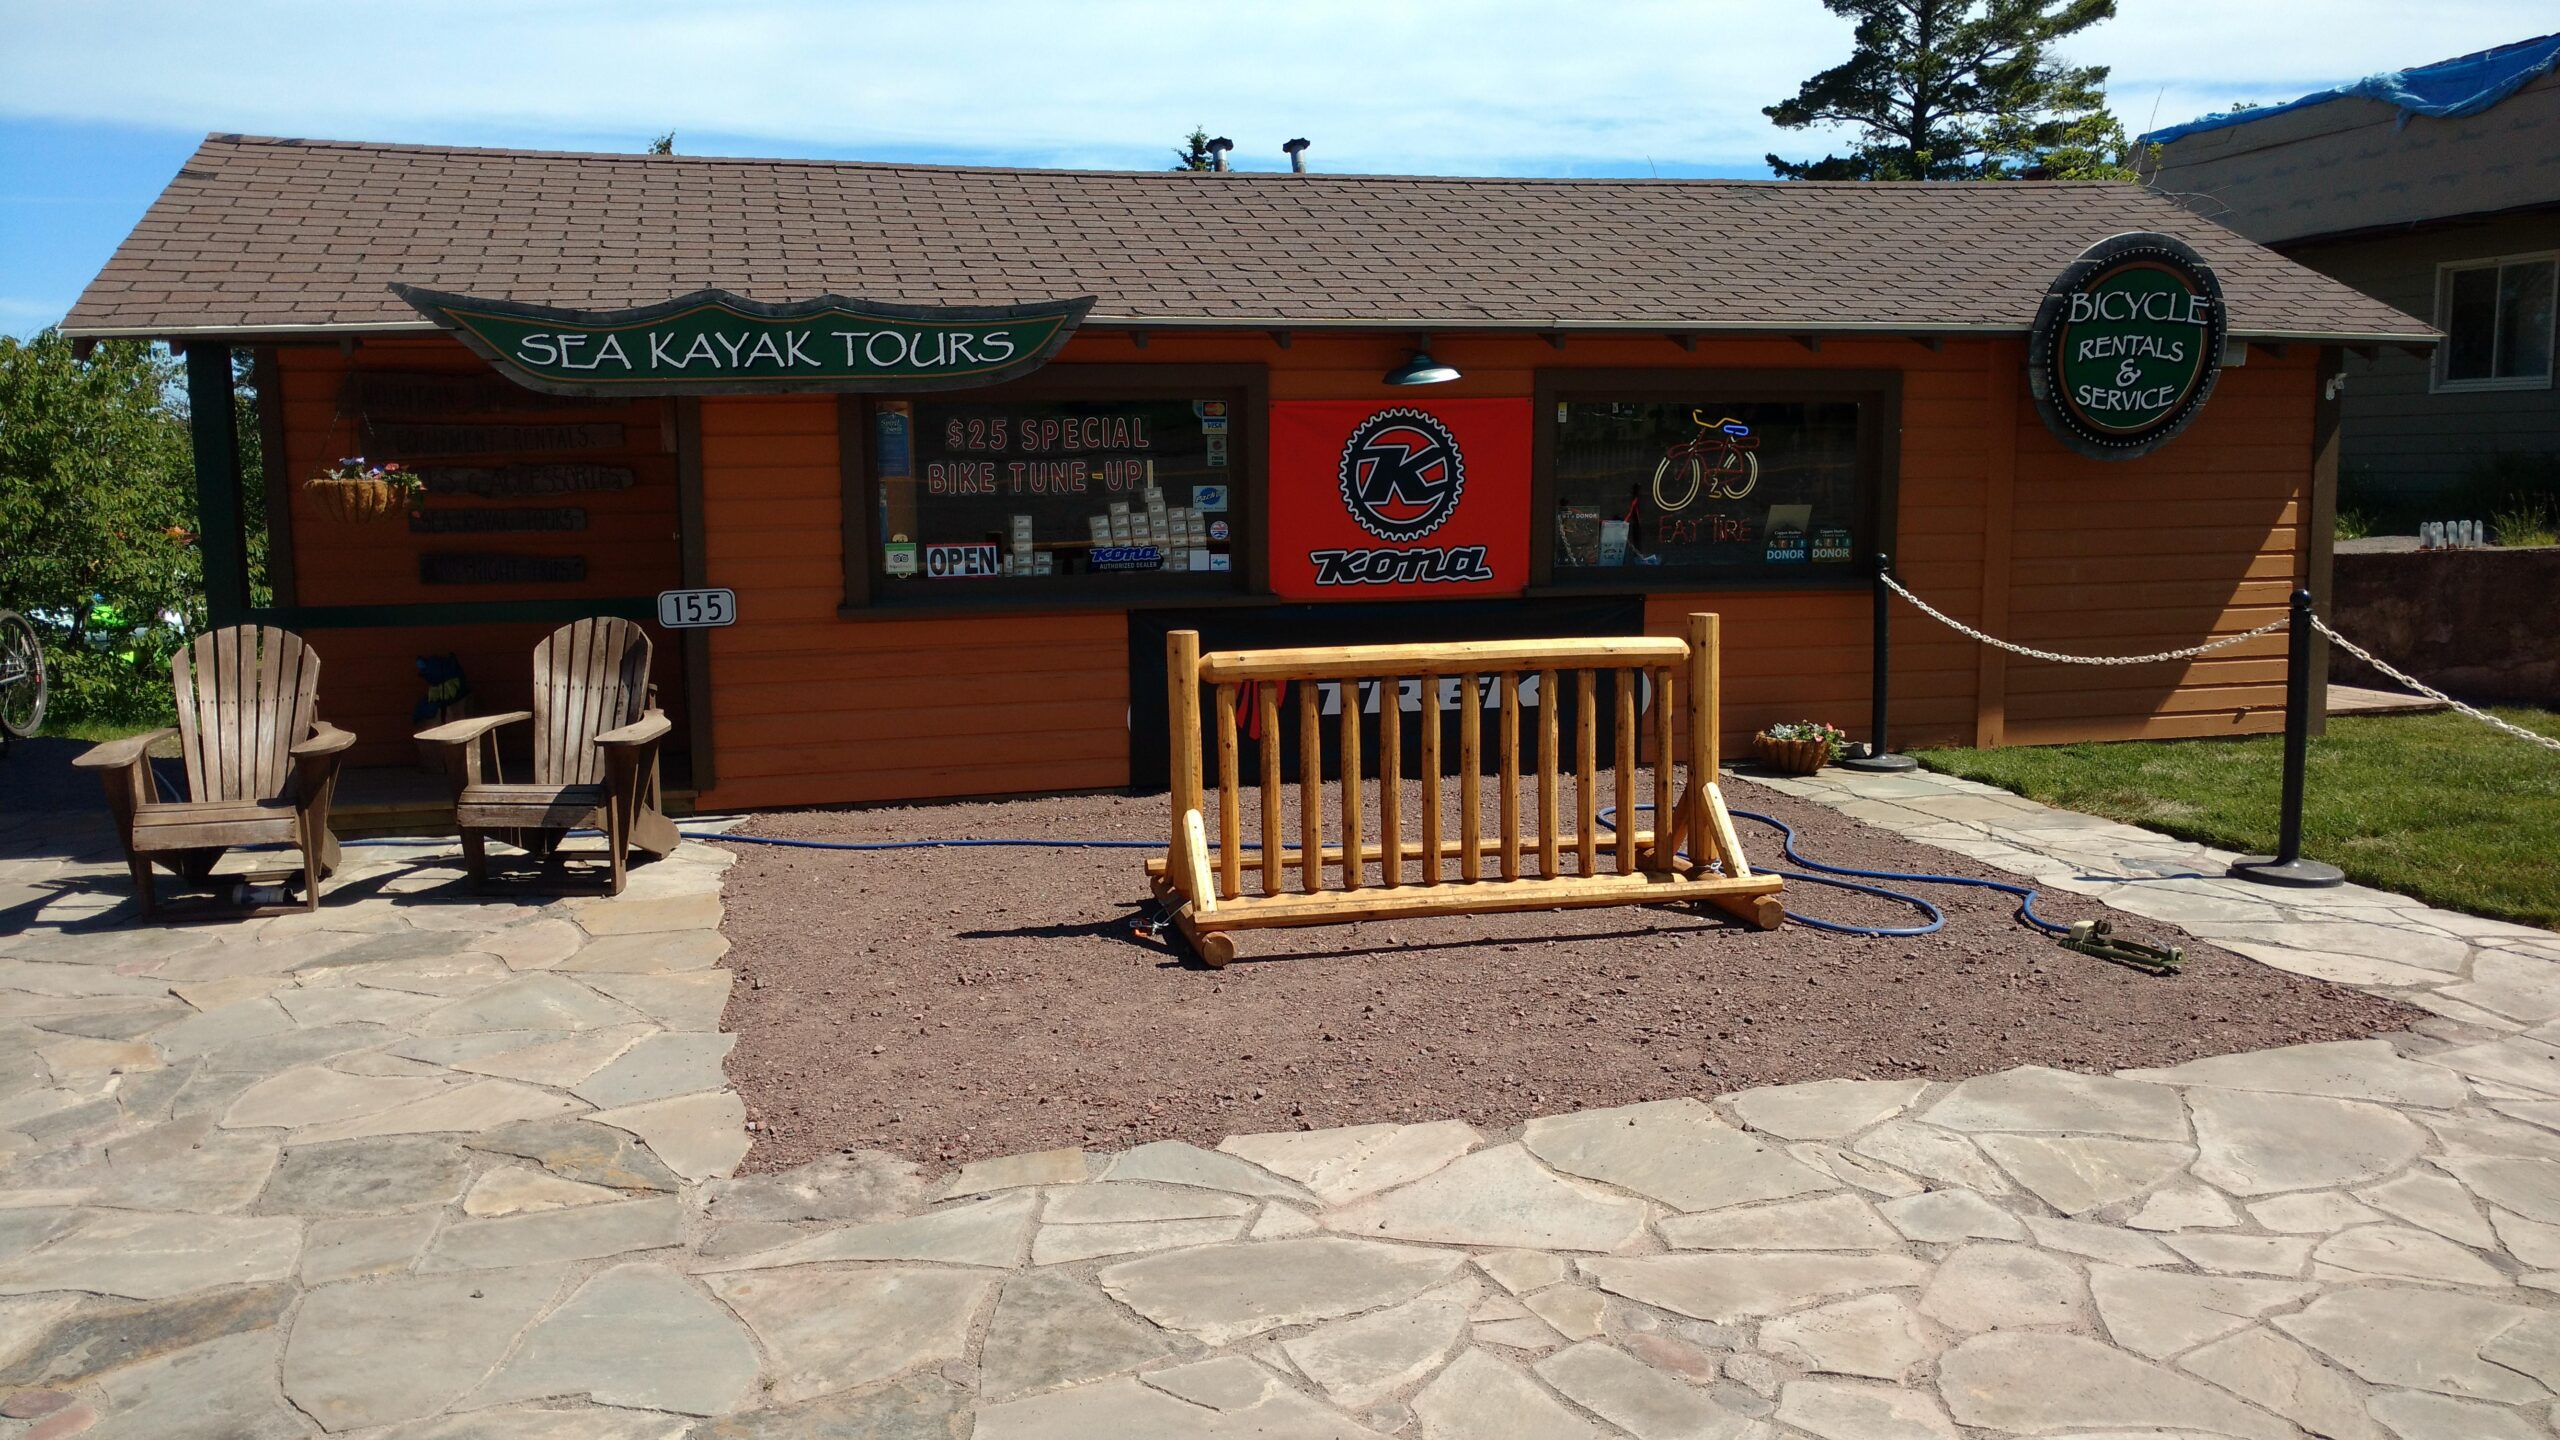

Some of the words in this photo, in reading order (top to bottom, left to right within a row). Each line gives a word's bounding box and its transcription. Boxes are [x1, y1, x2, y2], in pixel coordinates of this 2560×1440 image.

[2068, 291, 2210, 325] BICYCLE
[517, 334, 632, 370] SEA
[649, 331, 821, 368] KAYAK
[831, 331, 1015, 367] TOURS
[2077, 335, 2185, 362] RENTALS
[2115, 358, 2142, 387] &
[2075, 384, 2176, 410] SERVICE
[947, 418, 1008, 450] $25
[1021, 417, 1150, 450] SPECIAL
[928, 462, 996, 494] BIKE
[929, 547, 996, 576] OPEN
[1099, 562, 1135, 570] AUTHORIZED
[1136, 561, 1157, 569] DEALER
[1766, 549, 1805, 560] DONOR
[1812, 547, 1850, 558] DONOR
[673, 594, 722, 622] 155
